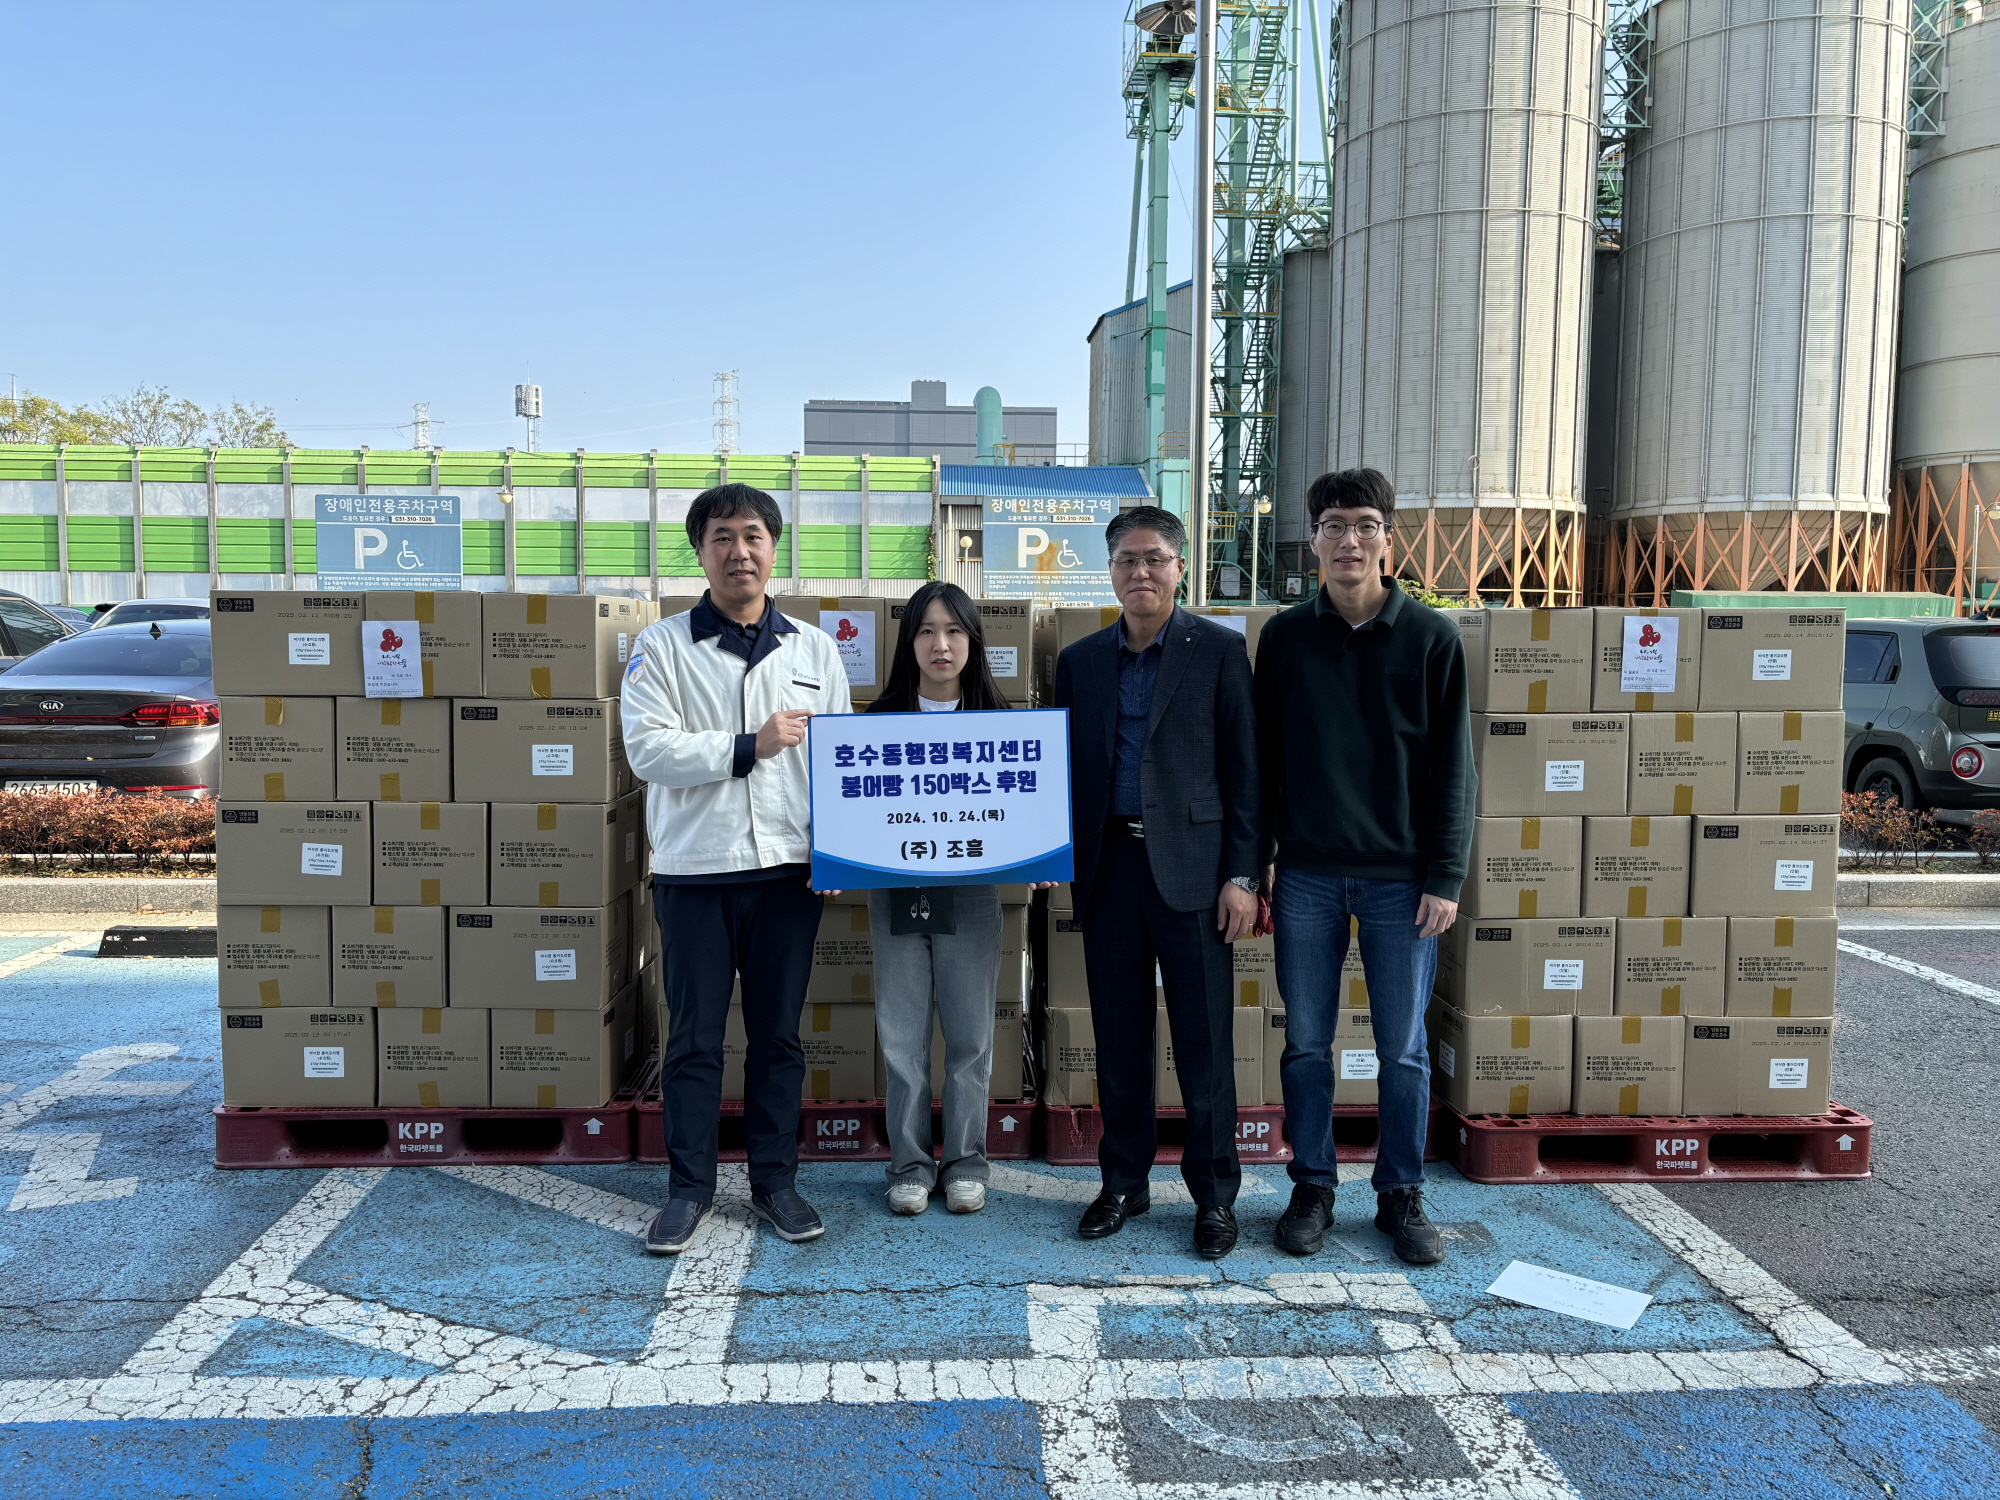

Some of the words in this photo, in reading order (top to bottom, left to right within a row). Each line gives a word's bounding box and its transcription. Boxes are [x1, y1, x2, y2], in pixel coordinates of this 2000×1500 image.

[324, 498, 453, 514] 장애인전용주차구역
[992, 499, 1111, 514] 장애인전용주차구역
[355, 528, 388, 569] P
[1018, 528, 1049, 568] P
[834, 740, 1042, 768] 호수동행정복지센터
[52, 783, 91, 796] 4503
[841, 776, 904, 798] 붕어빵
[910, 772, 990, 795] 150박스
[996, 770, 1036, 793] 후원
[887, 812, 926, 824] 2024.
[932, 812, 952, 822] 10.
[959, 809, 1005, 822] 24.(목)
[901, 840, 937, 860] (주)
[946, 839, 984, 858] 조흥
[399, 1122, 444, 1139] KPP
[817, 1120, 860, 1136] KPP
[399, 1144, 443, 1153] 한국파렛트풀
[818, 1140, 860, 1149] 한국파렛트풀
[1656, 1139, 1699, 1157] KPP
[1656, 1160, 1698, 1169] 한국파렛트풀
